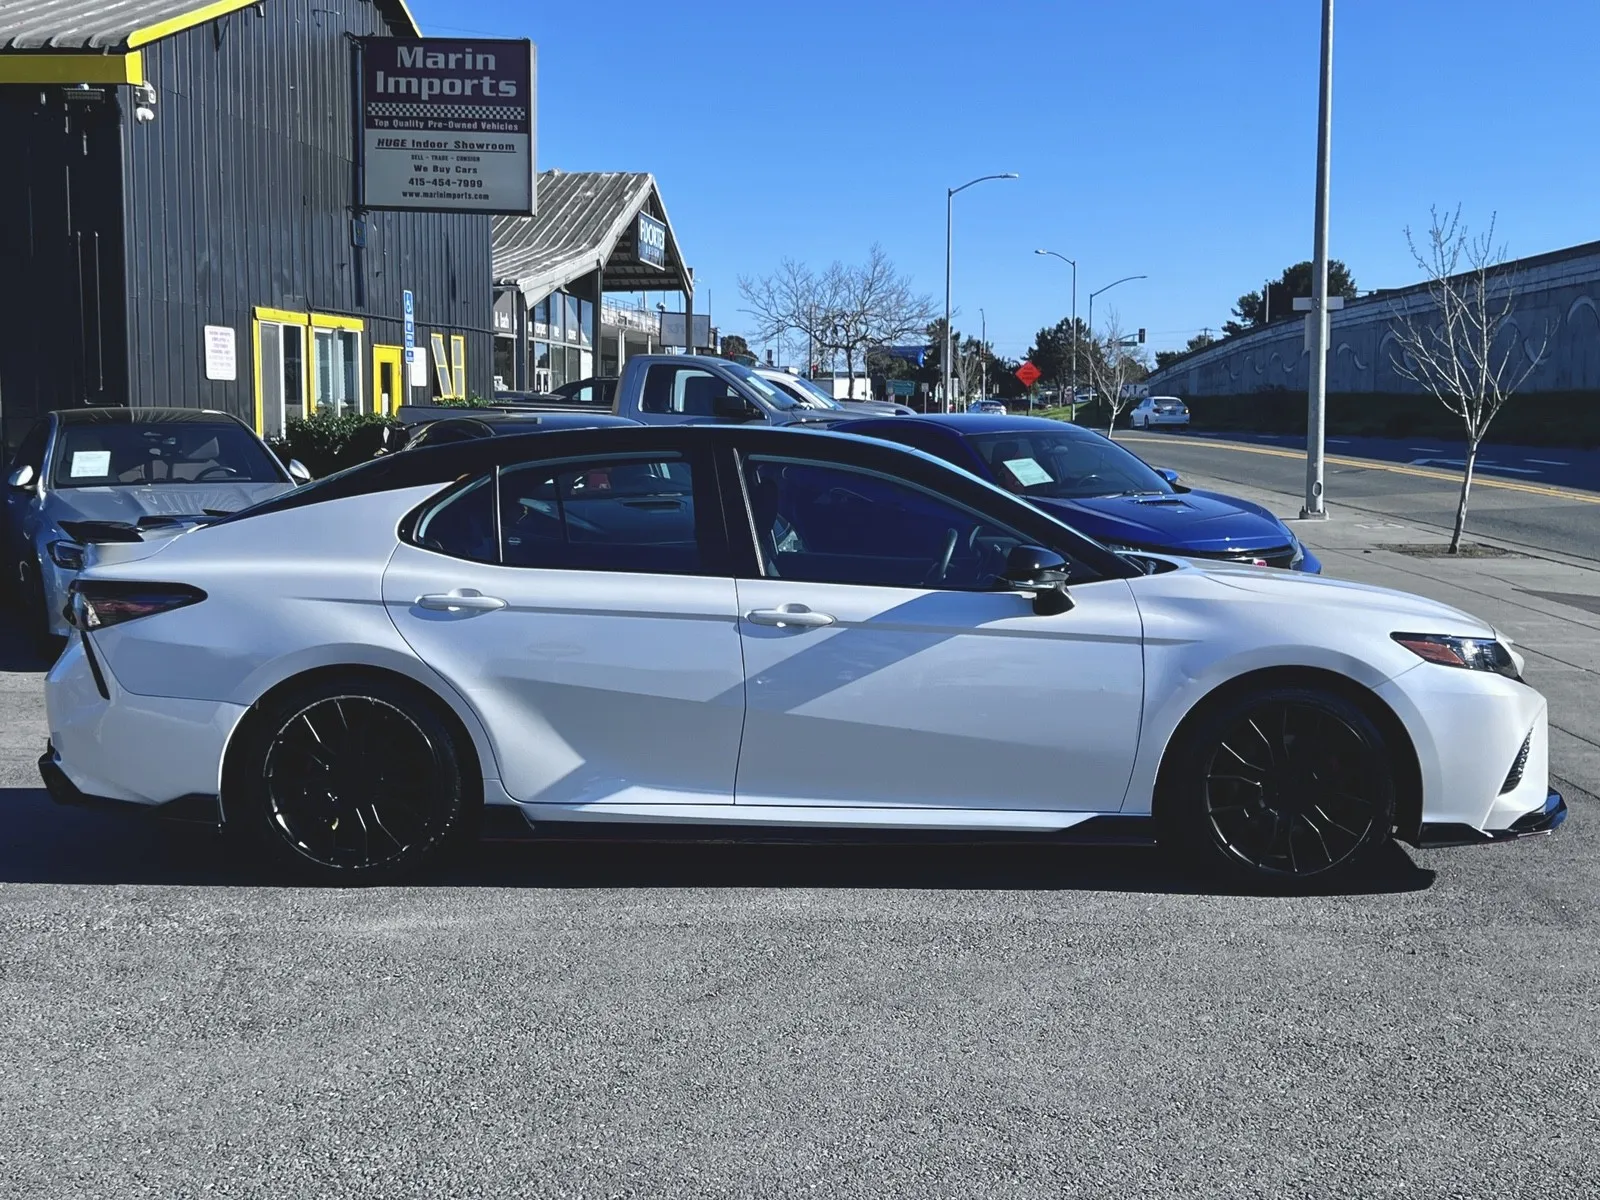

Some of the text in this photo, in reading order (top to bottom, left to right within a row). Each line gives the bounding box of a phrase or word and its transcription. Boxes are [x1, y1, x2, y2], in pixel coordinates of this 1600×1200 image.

[397, 46, 495, 70] Marin
[376, 71, 516, 100] Imports
[374, 118, 519, 131] Top Quality Pre-Owned Vehicles
[377, 138, 515, 151] HUGE Indoor Showroom
[413, 164, 478, 175] We Buy Cars
[408, 177, 483, 188] 415-454-7999
[401, 190, 490, 201] www.marinimports.com
